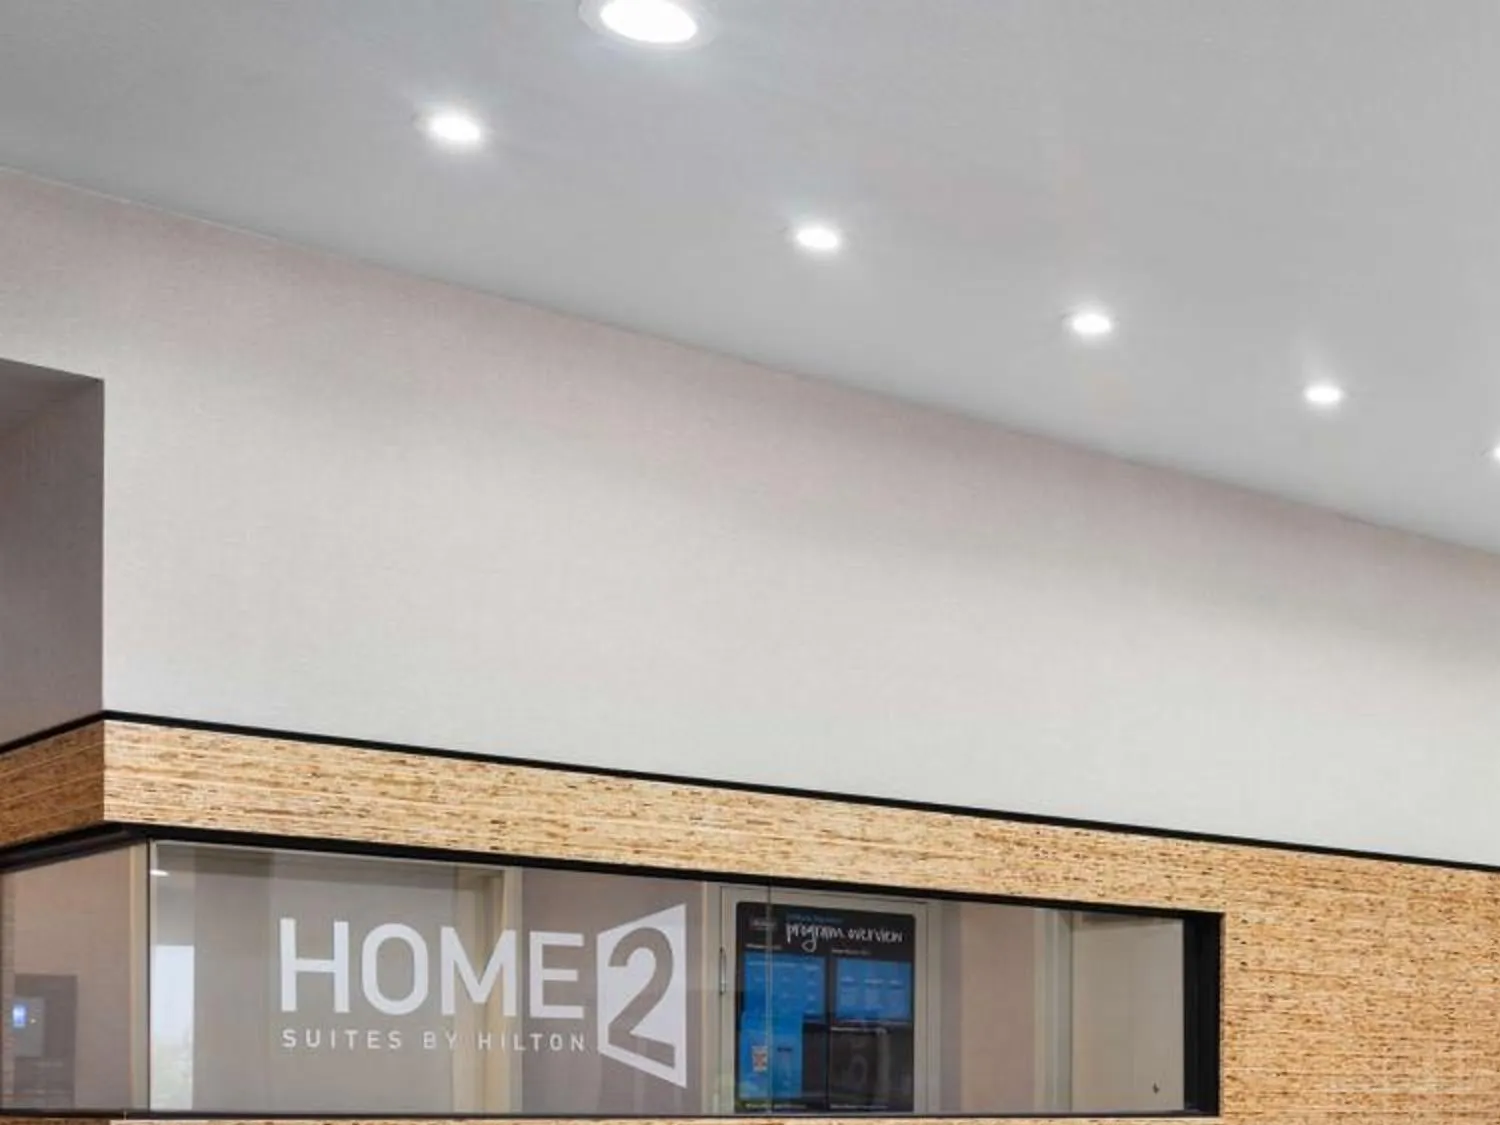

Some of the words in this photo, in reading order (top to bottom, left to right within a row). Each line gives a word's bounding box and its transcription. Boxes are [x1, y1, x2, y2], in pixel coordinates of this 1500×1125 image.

[785, 922, 844, 953] program
[847, 926, 904, 944] overview
[281, 1028, 402, 1049] SUITES
[423, 1032, 457, 1050] BY
[478, 1032, 585, 1051] HILTON
